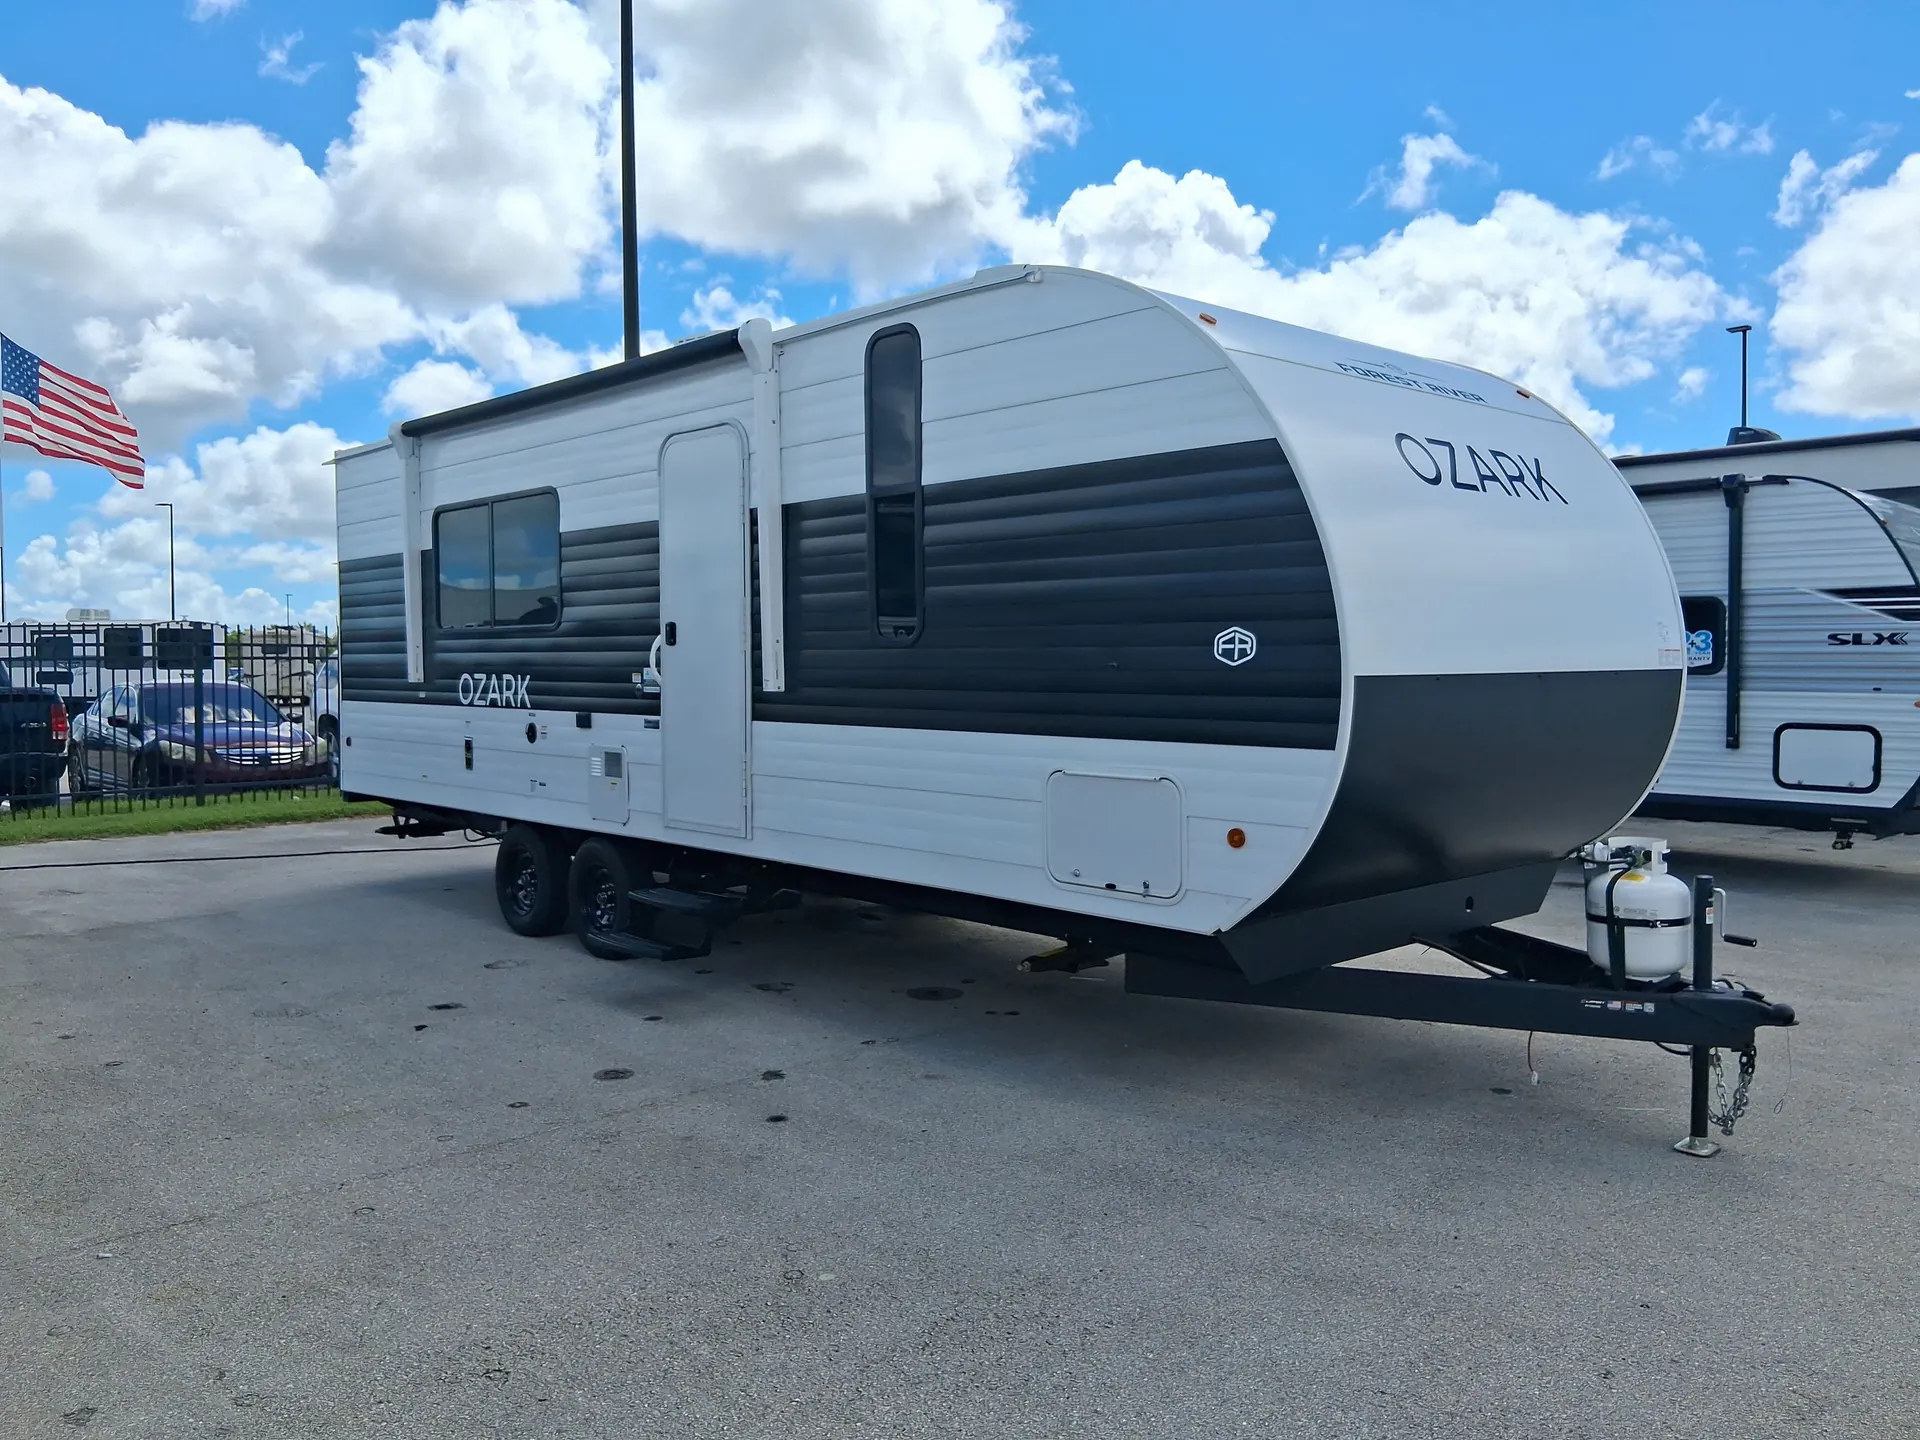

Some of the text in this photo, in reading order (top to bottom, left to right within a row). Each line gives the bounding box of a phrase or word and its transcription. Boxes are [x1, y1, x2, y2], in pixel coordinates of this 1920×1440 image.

[1333, 361, 1488, 404] FOREST RIVER
[1394, 432, 1569, 505] OZARK
[1827, 632, 1909, 646] SLX
[458, 672, 532, 708] OZARK
